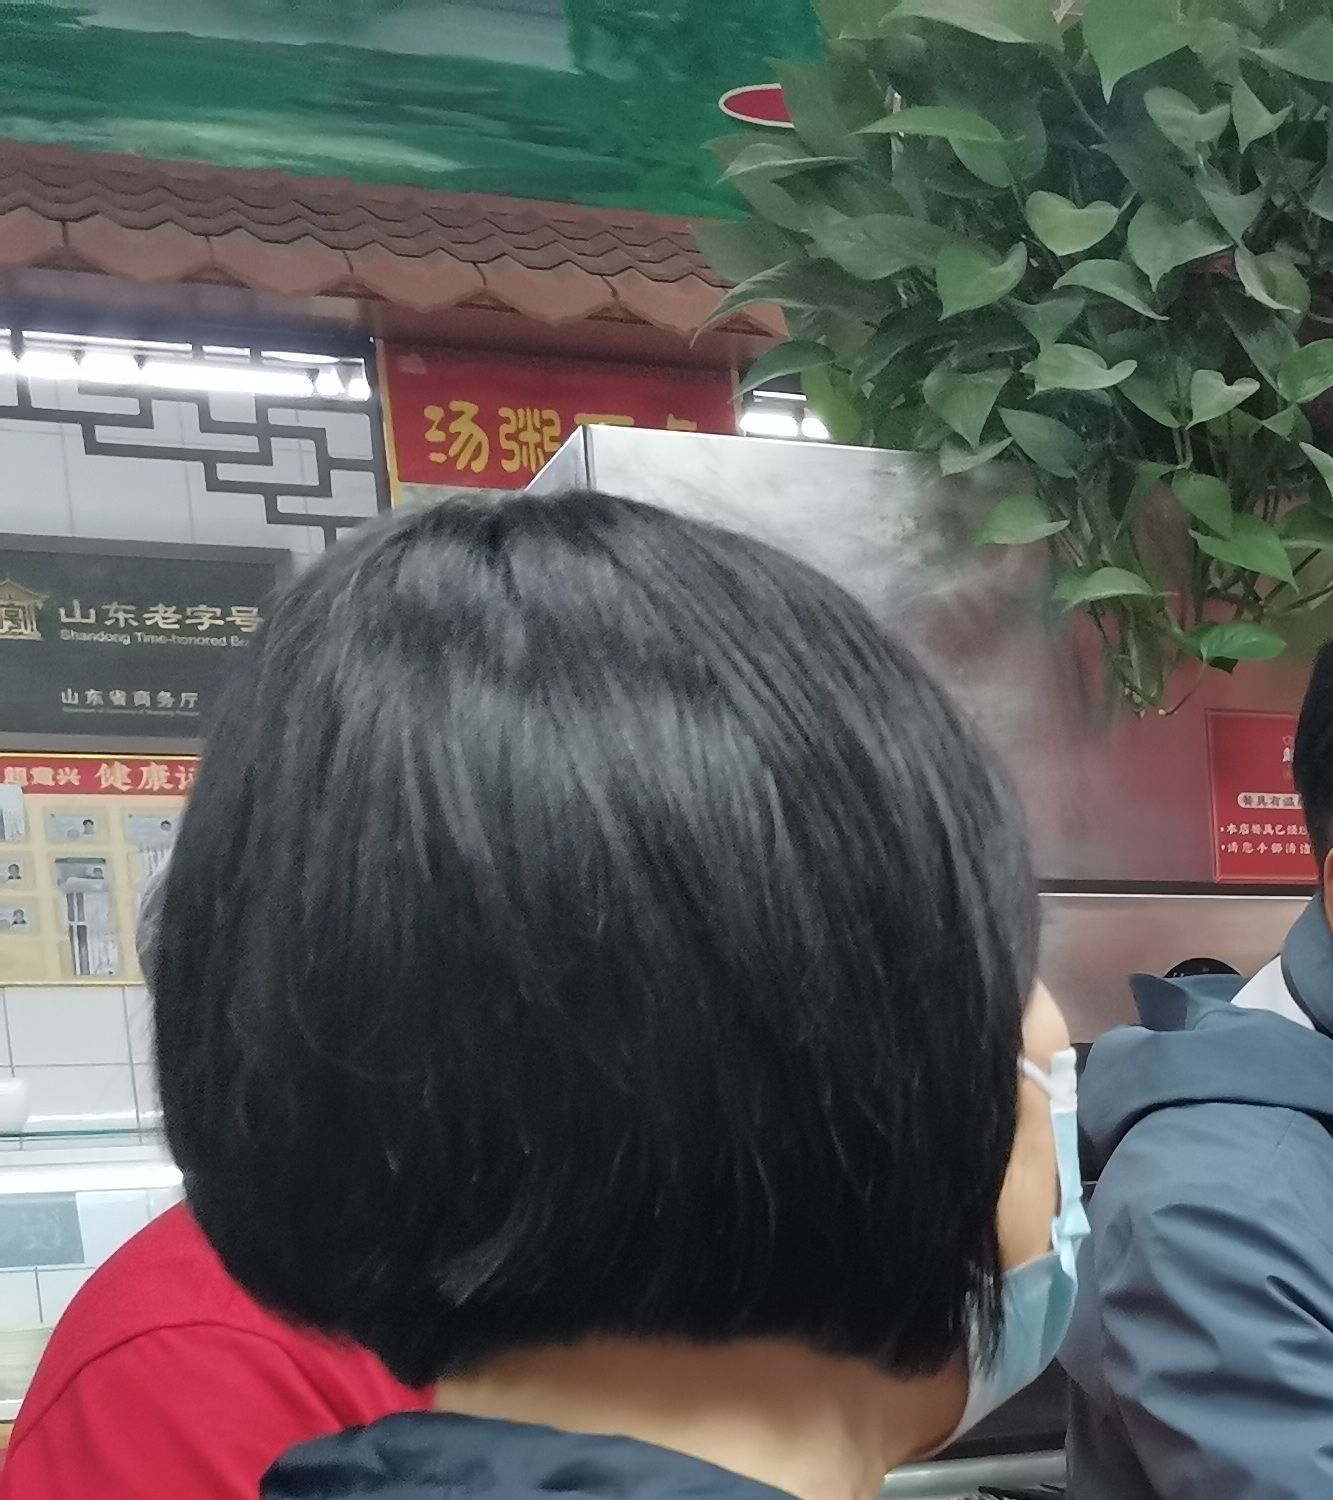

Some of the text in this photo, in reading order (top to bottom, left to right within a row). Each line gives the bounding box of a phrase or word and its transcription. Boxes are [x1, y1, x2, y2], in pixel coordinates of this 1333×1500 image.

[58, 599, 264, 633] 山东老字号
[60, 629, 131, 645] Shandong
[135, 632, 227, 647] Time-honored
[61, 687, 199, 708] 山东省商务厅
